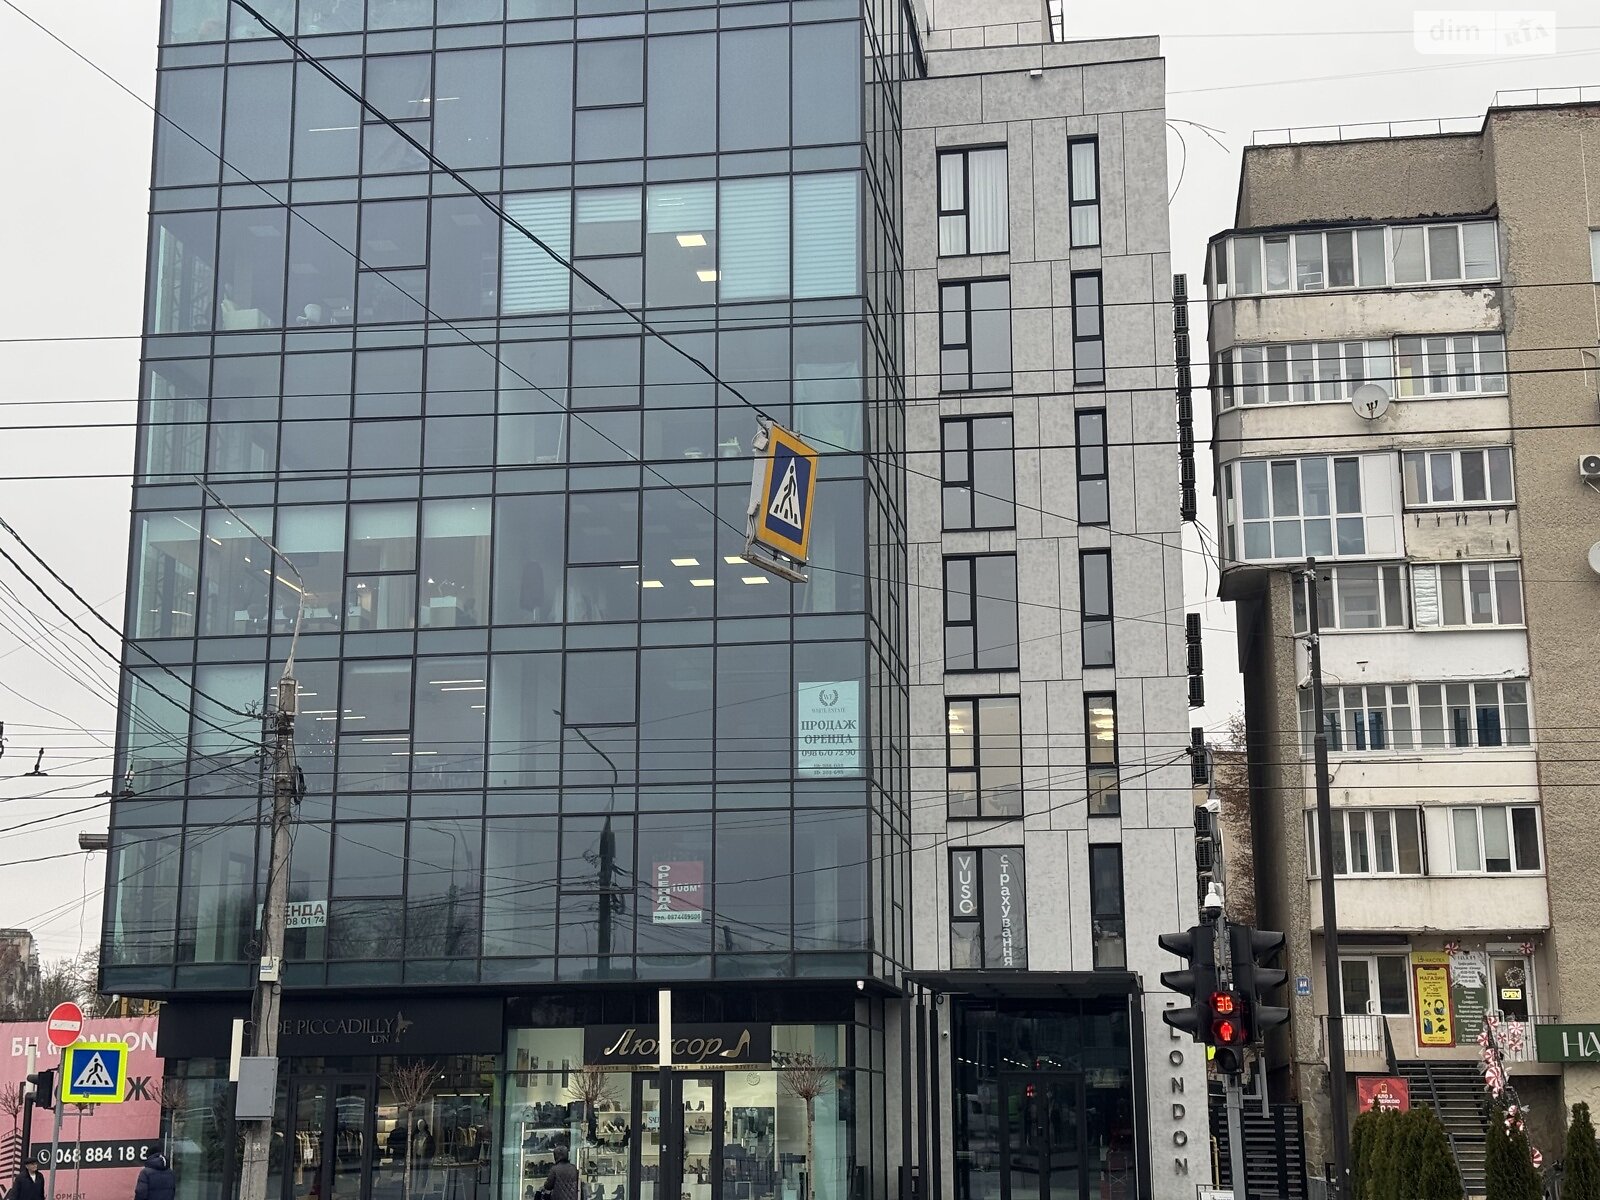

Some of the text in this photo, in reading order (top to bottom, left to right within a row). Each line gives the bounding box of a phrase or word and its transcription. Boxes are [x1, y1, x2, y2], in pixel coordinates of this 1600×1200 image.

[801, 719, 857, 732] ПРОДАЖ
[804, 733, 854, 745] ОРЕНДА
[657, 865, 671, 911] ОРЕНДА
[958, 856, 974, 914] VUSO
[285, 903, 325, 917] ЕНДА
[1000, 854, 1013, 967] страхування
[300, 916, 311, 925] 01
[314, 916, 325, 924] 74
[1503, 990, 1520, 998] OPEN
[1217, 996, 1234, 1012] 36
[297, 1018, 396, 1035] PICCADILLY
[56, 1145, 149, 1163] 068 884 18 8
